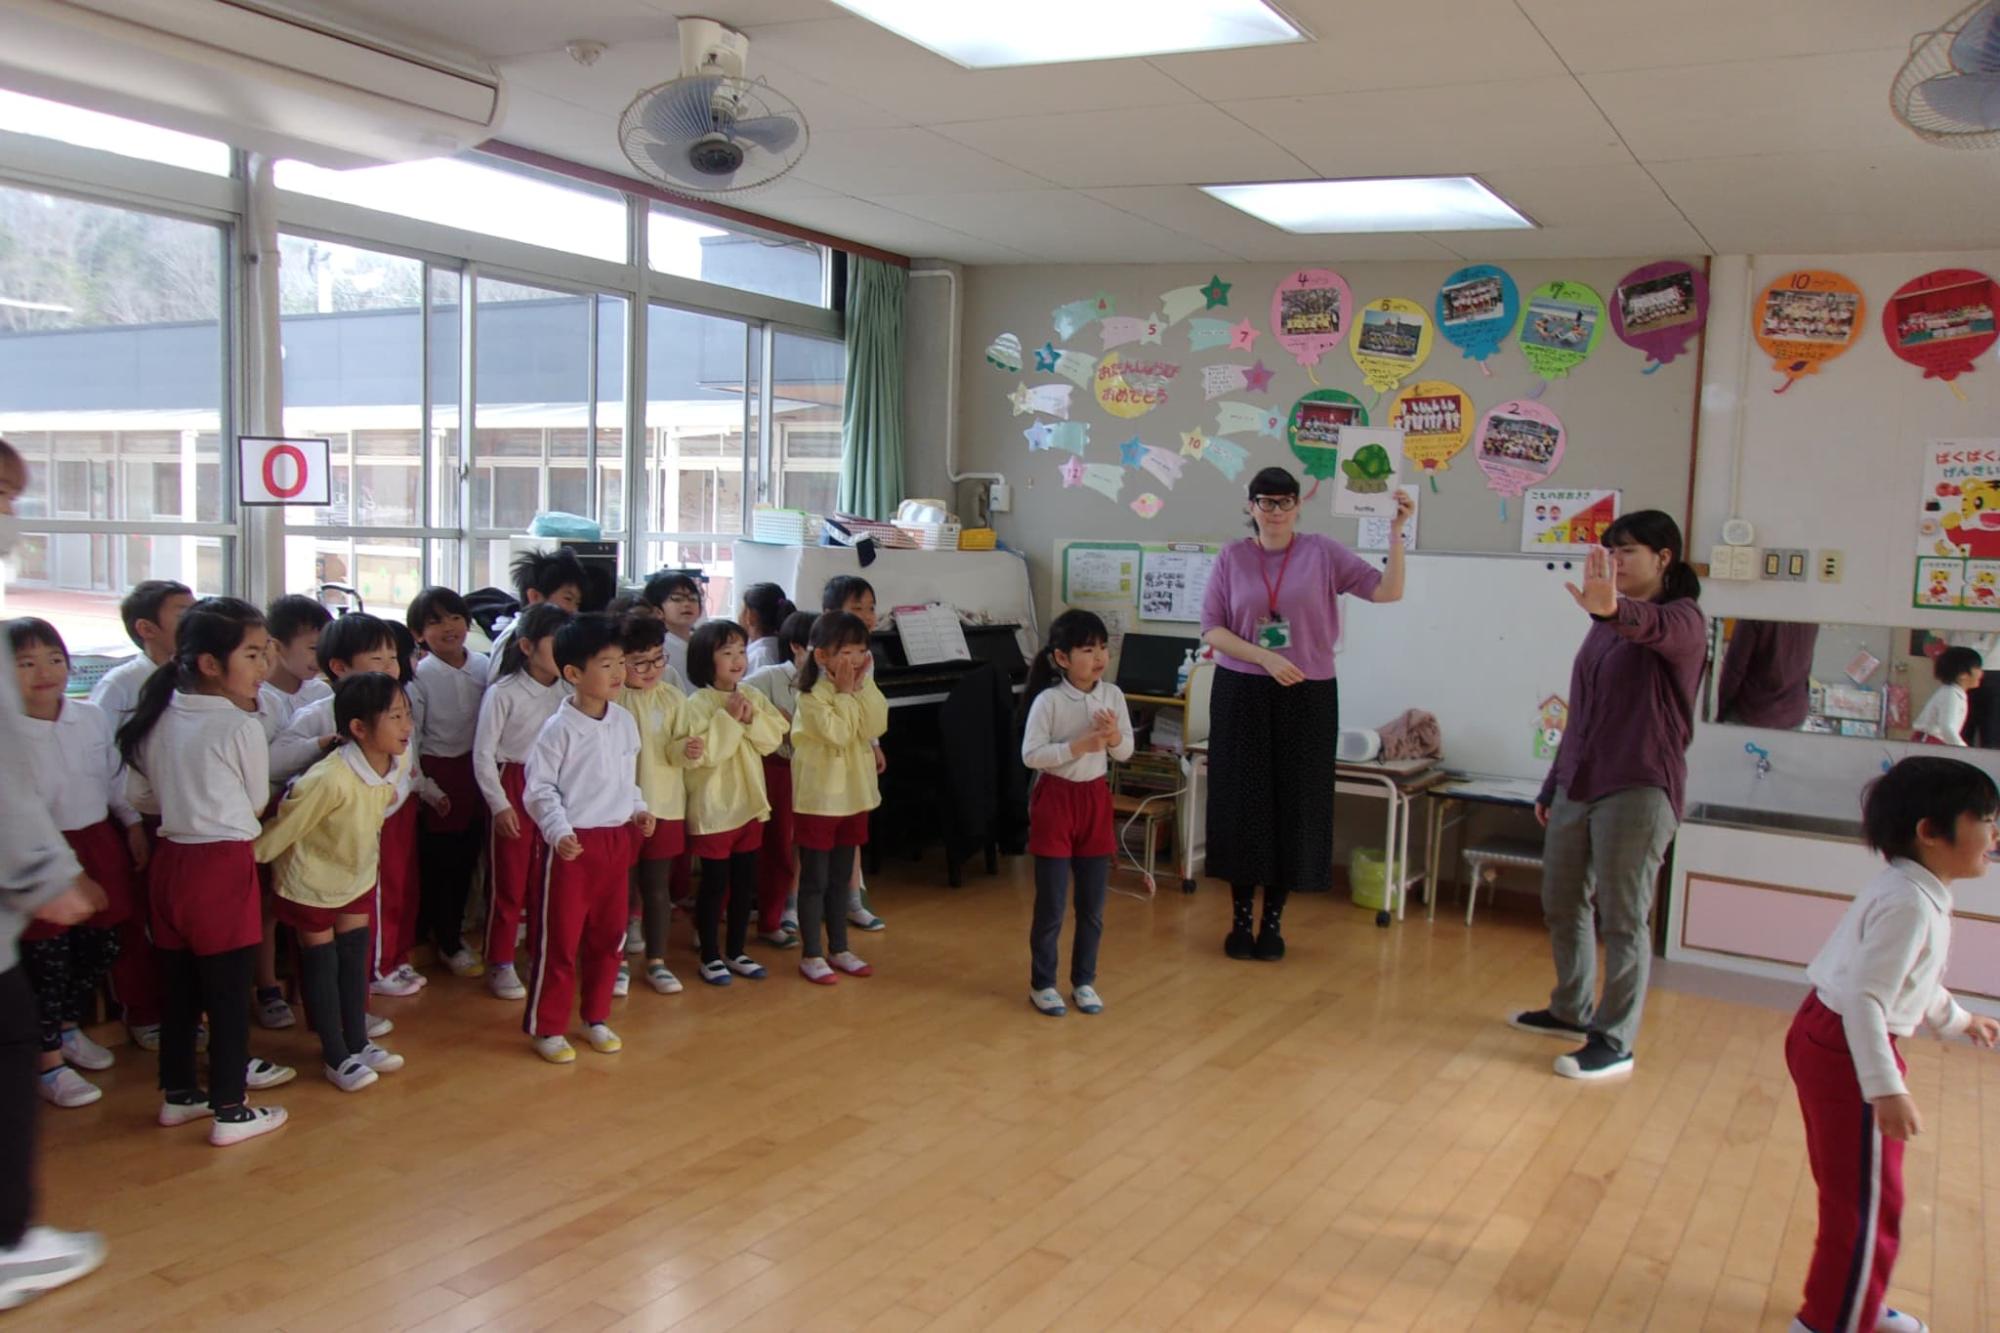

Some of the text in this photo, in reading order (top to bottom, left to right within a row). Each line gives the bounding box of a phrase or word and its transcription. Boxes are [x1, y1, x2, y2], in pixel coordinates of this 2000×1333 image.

[1297, 272, 1309, 287] 4
[1550, 281, 1565, 300] 7
[1381, 299, 1392, 312] 5
[1147, 323, 1157, 335] 5
[1240, 331, 1249, 343] 7
[1101, 387, 1169, 404] おめでとう
[1507, 402, 1521, 415] 2
[1268, 417, 1278, 429] 9
[1189, 437, 1201, 449] 10
